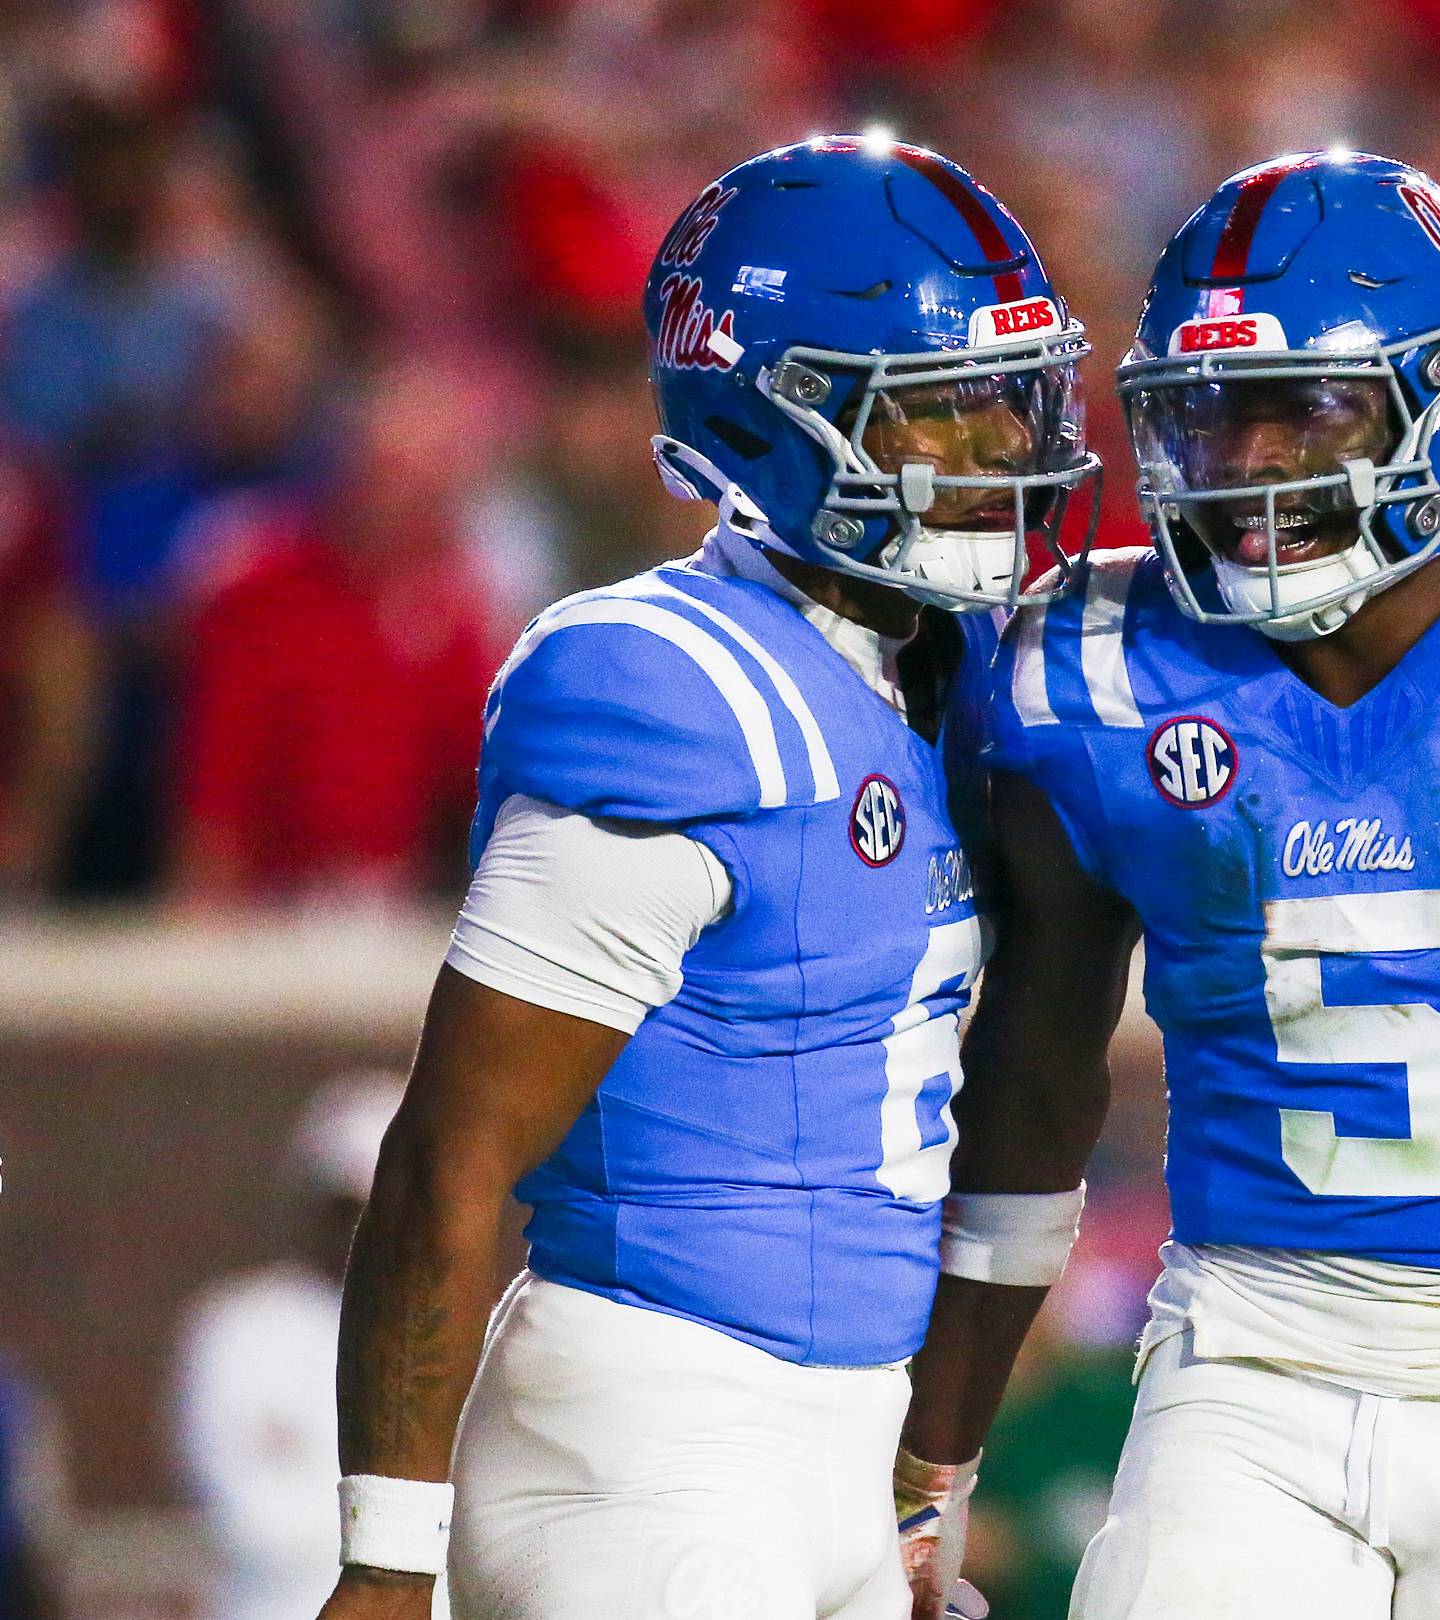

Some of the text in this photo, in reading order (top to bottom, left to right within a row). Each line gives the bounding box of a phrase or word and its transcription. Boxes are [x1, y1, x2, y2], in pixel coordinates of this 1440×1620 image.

[661, 183, 740, 267] Ole
[990, 302, 1054, 335] REBS
[1180, 320, 1257, 351] REBS
[1153, 721, 1231, 801] SEC
[856, 778, 902, 860] SEC
[1282, 818, 1416, 877] Ole Miss
[875, 915, 982, 1203] 6
